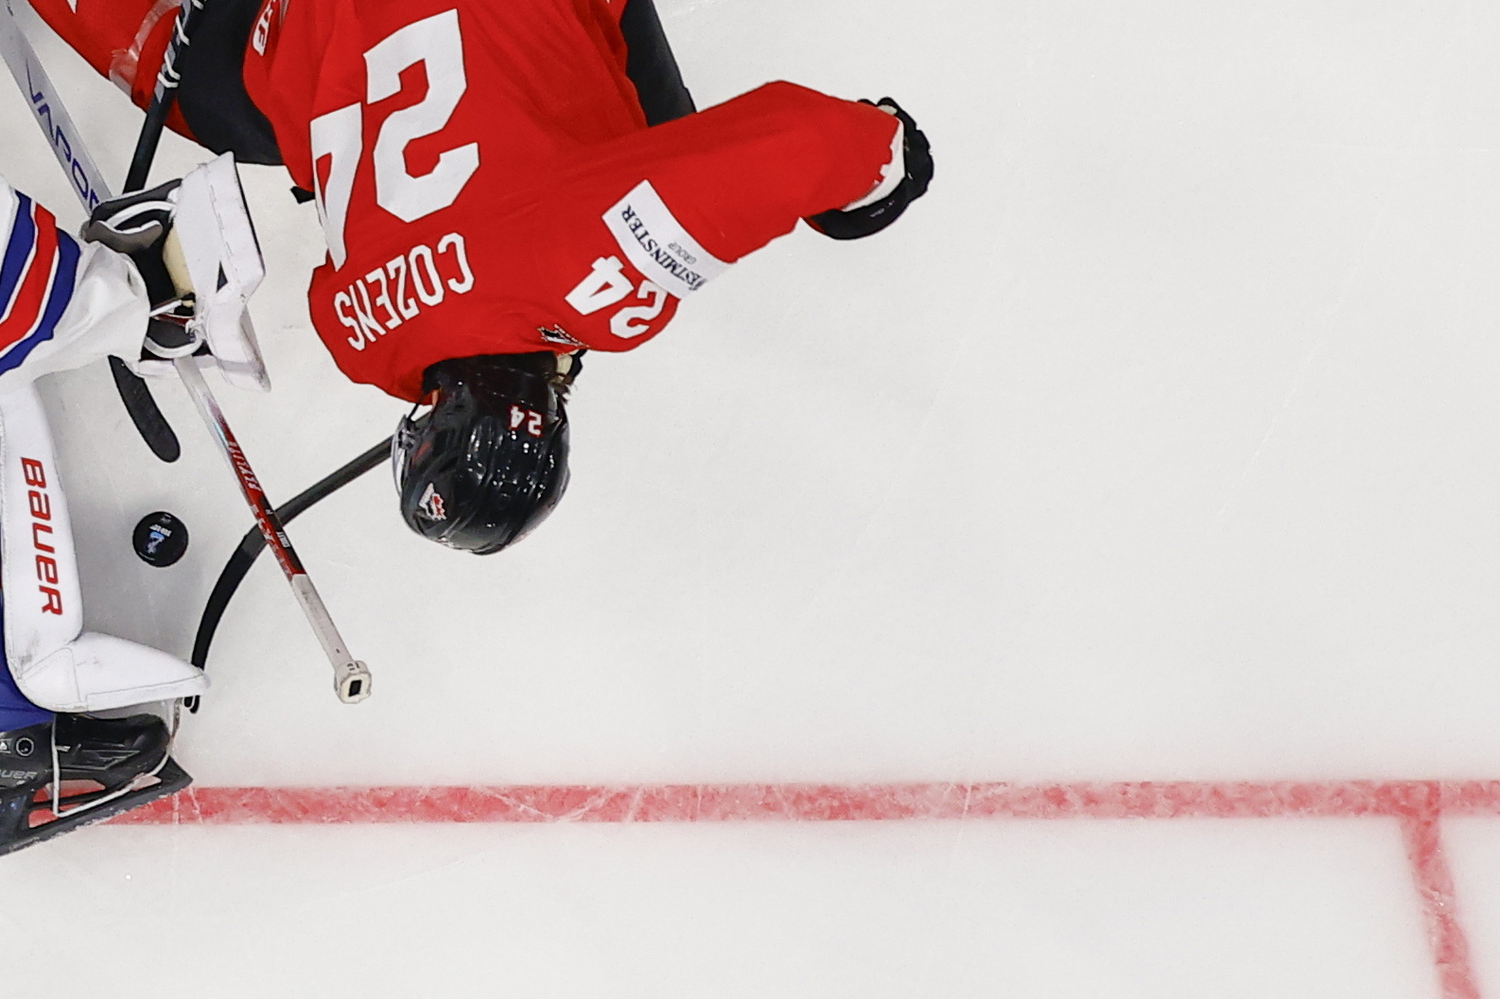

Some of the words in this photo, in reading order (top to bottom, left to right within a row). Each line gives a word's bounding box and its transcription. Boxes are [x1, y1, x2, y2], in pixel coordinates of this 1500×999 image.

[310, 8, 481, 272] 24
[621, 204, 707, 291] ESTMINSTER
[668, 242, 697, 265] GROUP
[333, 232, 475, 351] COZENS
[565, 255, 668, 339] 24
[510, 404, 544, 437] 24
